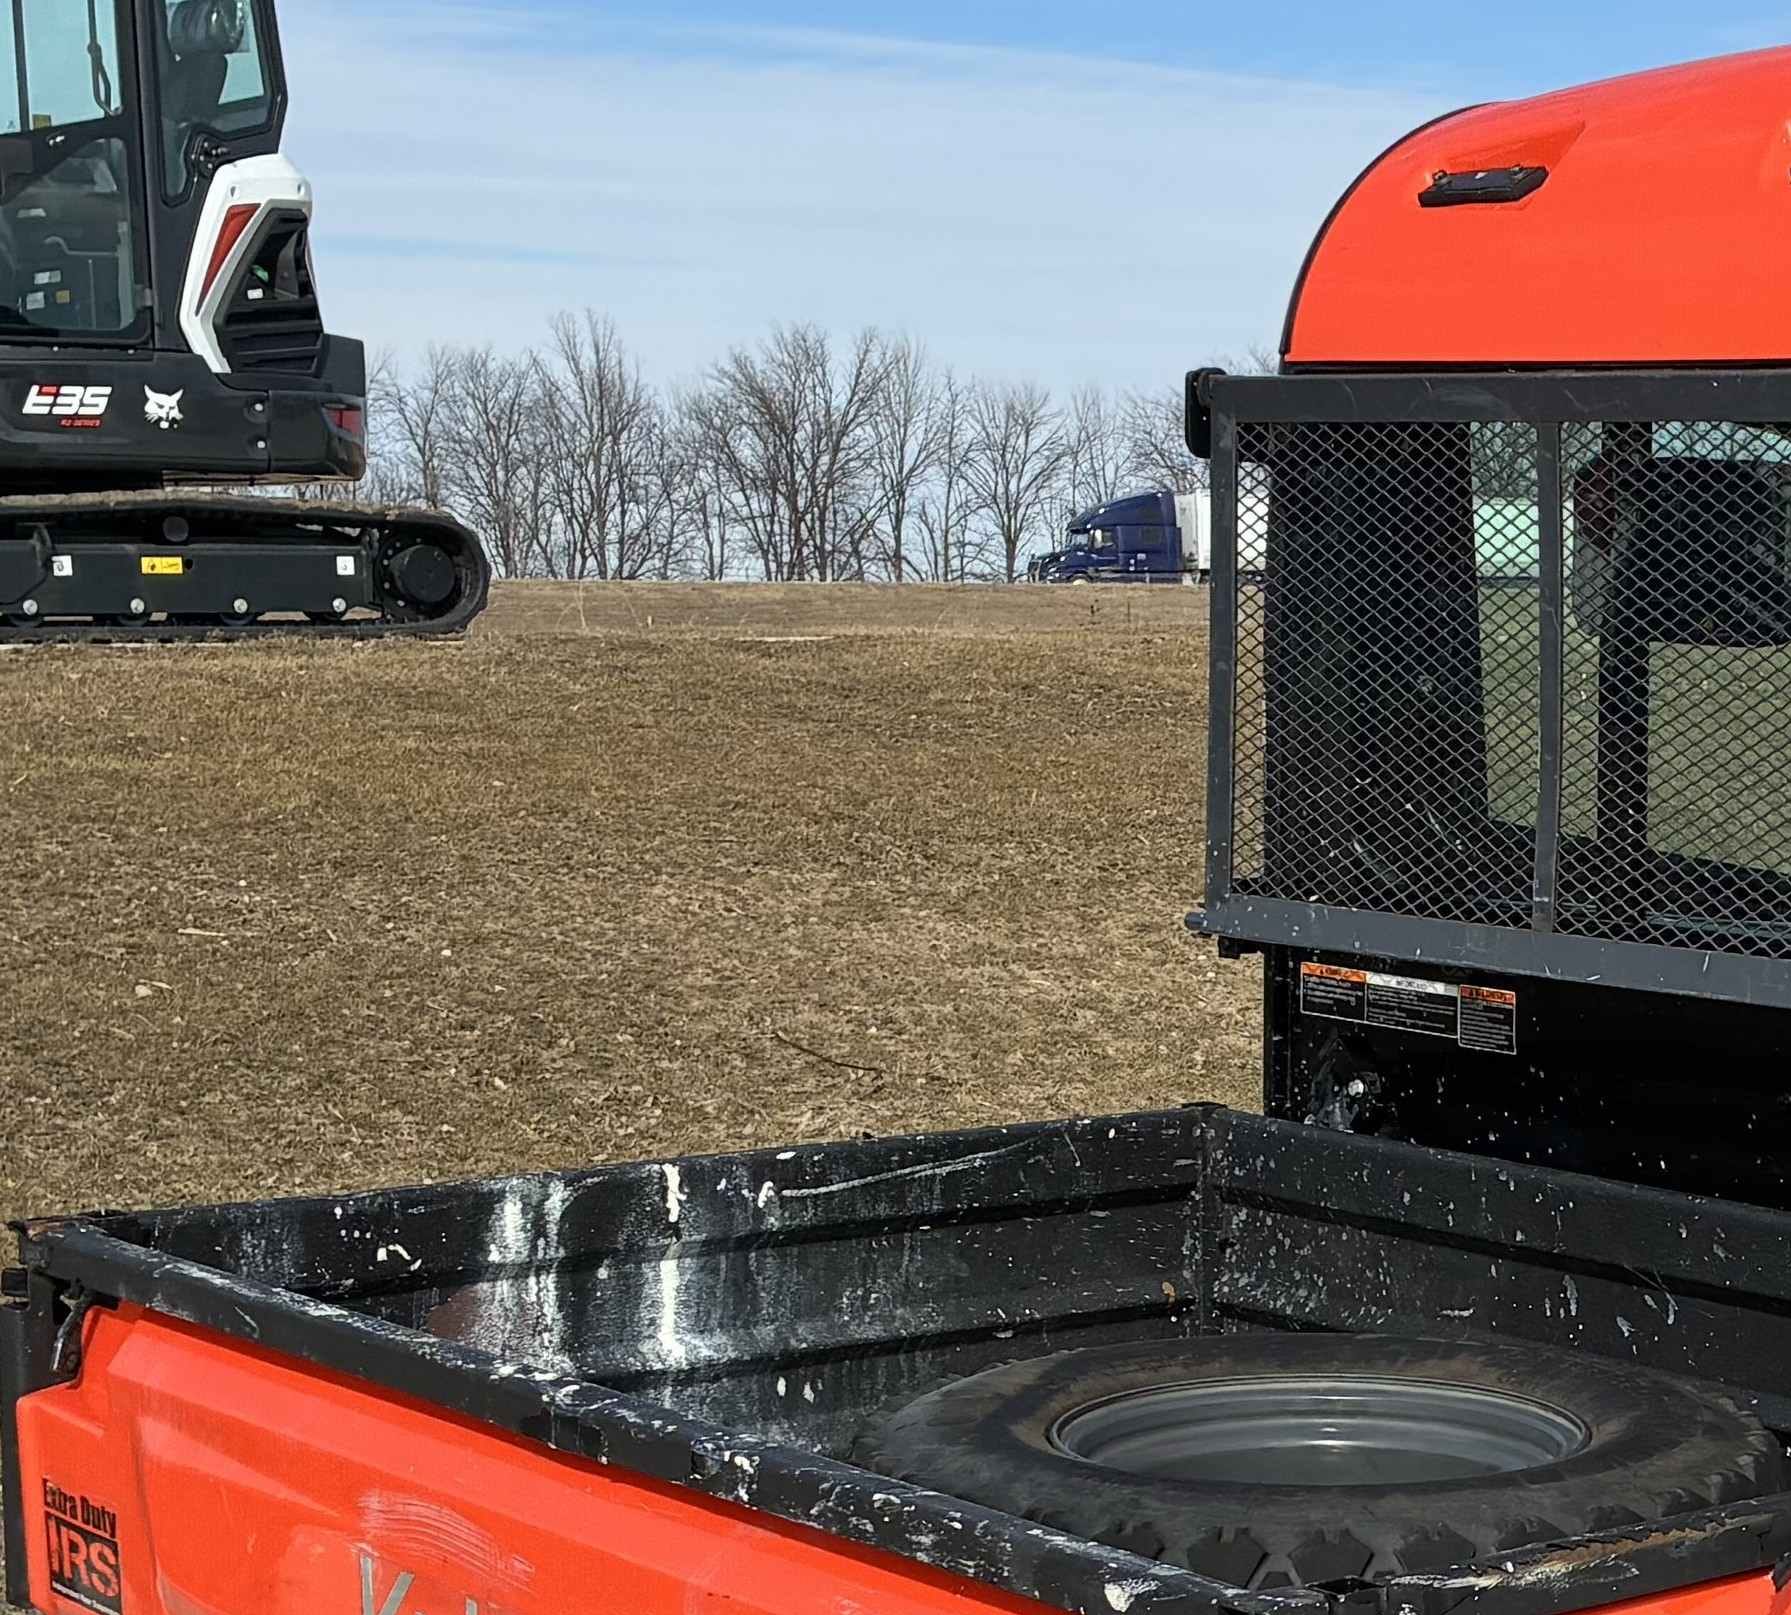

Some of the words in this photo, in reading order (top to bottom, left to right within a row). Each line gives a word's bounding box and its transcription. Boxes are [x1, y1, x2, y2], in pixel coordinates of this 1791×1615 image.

[22, 384, 113, 416] E35
[80, 1495, 117, 1540] Duty
[48, 1517, 119, 1597] IRS
